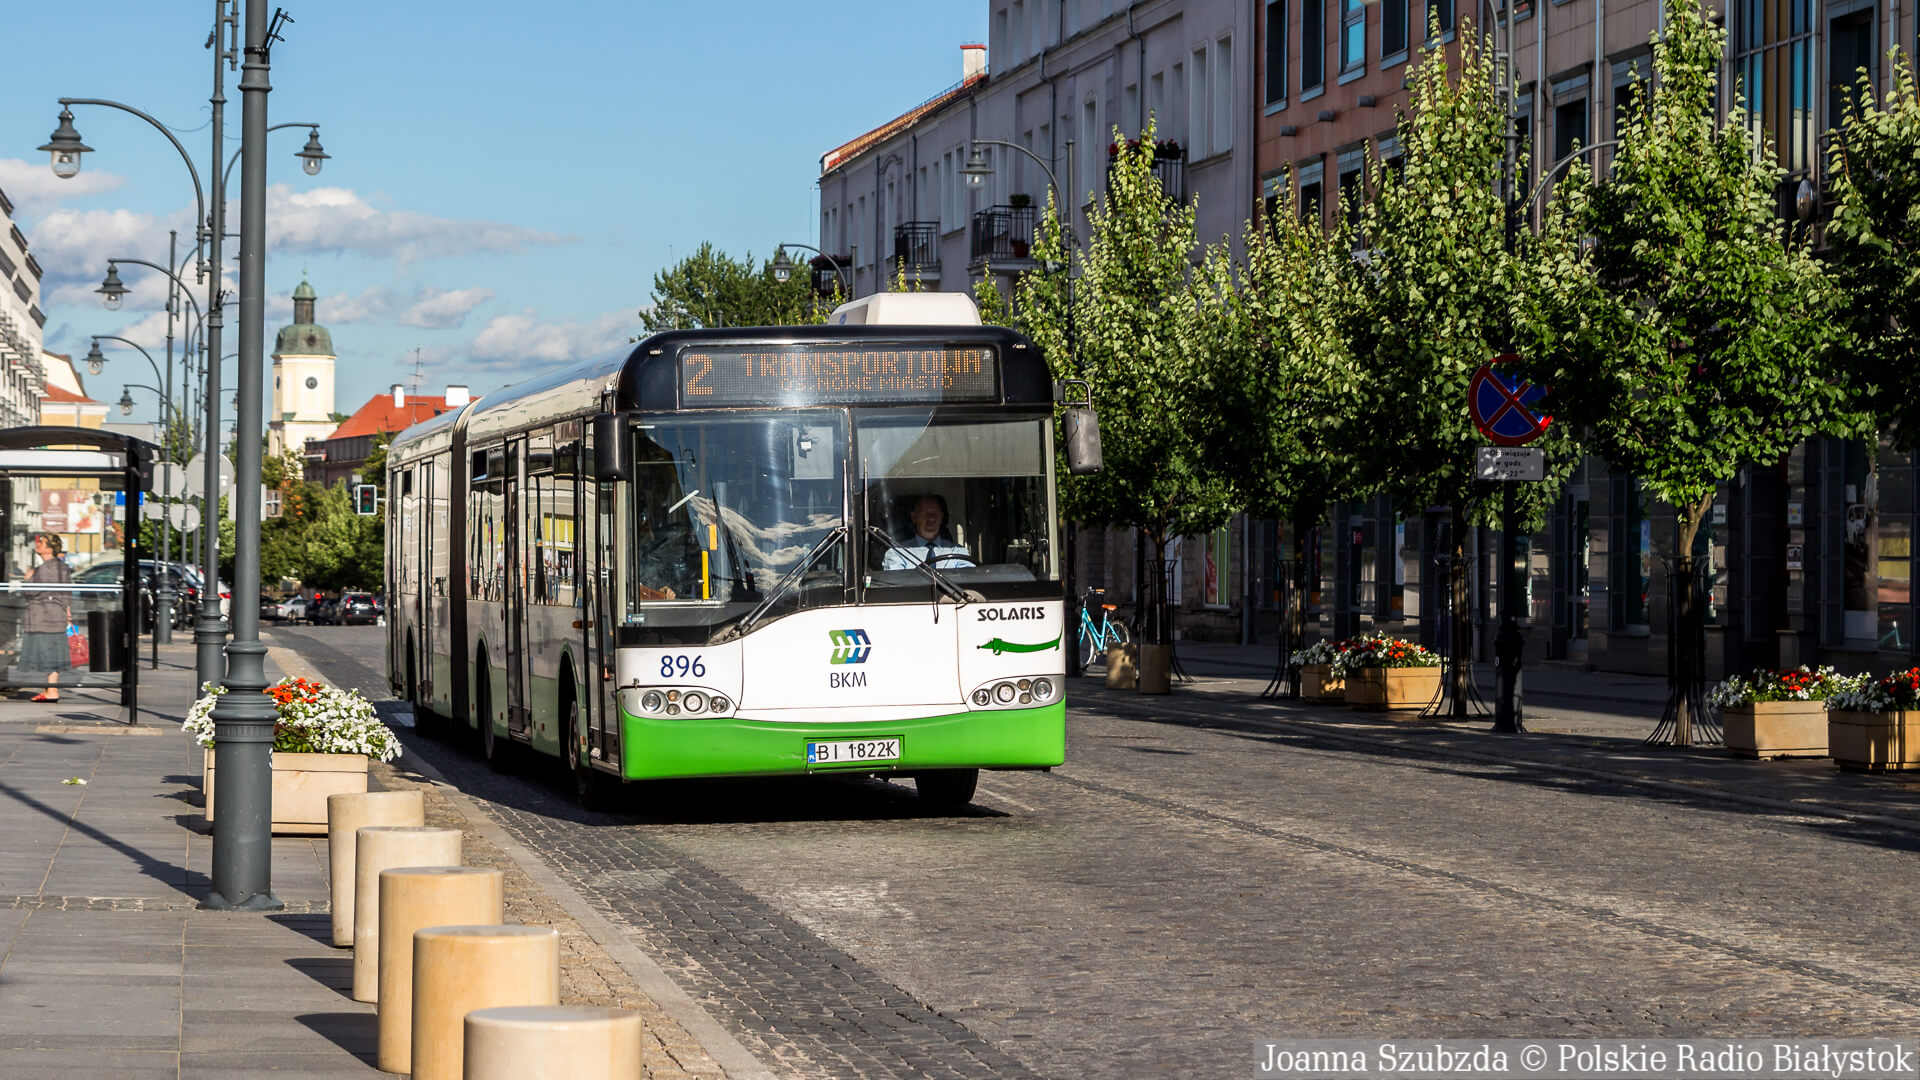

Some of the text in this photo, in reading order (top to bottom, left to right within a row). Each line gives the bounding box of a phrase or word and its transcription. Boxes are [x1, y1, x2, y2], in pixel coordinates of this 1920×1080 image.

[686, 349, 981, 395] 2 TRANSPORTOWA
[879, 375, 953, 390] MIASTO
[977, 606, 1045, 621] SOLARIS
[660, 654, 706, 678] 896
[830, 671, 867, 689] BKM
[818, 741, 896, 761] BI 1822K
